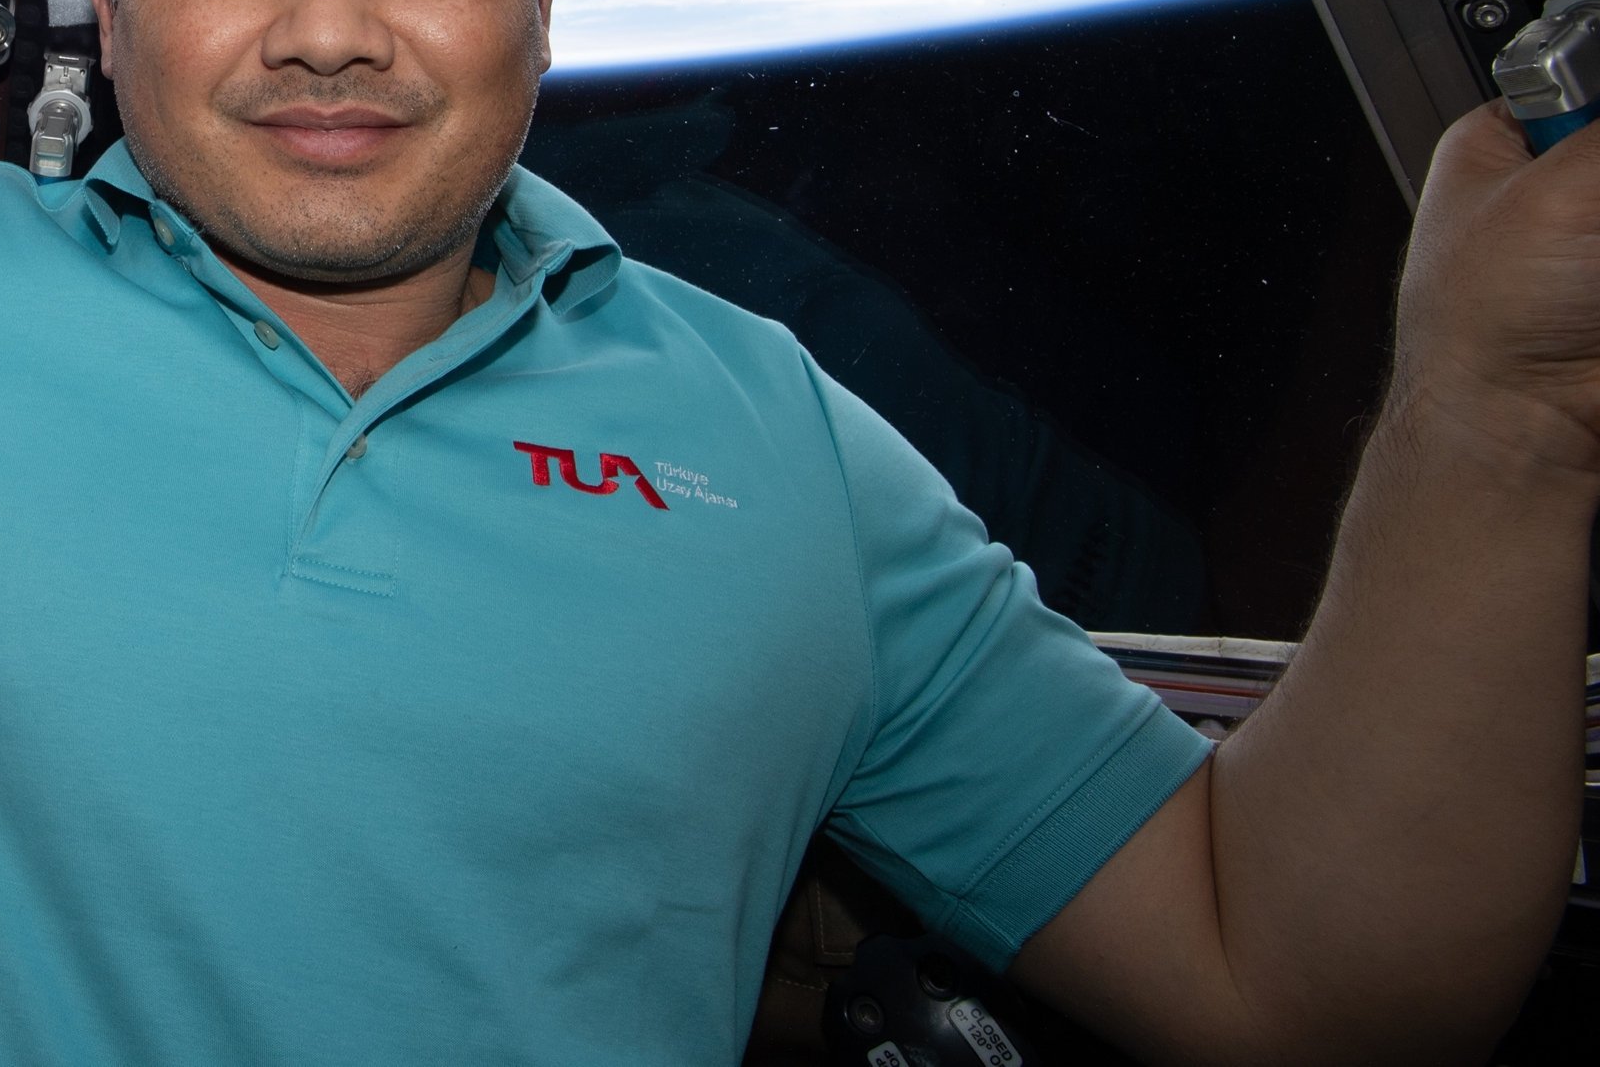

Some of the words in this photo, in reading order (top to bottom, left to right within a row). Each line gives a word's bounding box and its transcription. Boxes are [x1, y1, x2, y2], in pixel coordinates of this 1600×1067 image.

[512, 440, 671, 511] TUA
[656, 476, 691, 499] Uzay
[955, 1008, 968, 1022] or
[970, 1007, 1013, 1061] CLOSED
